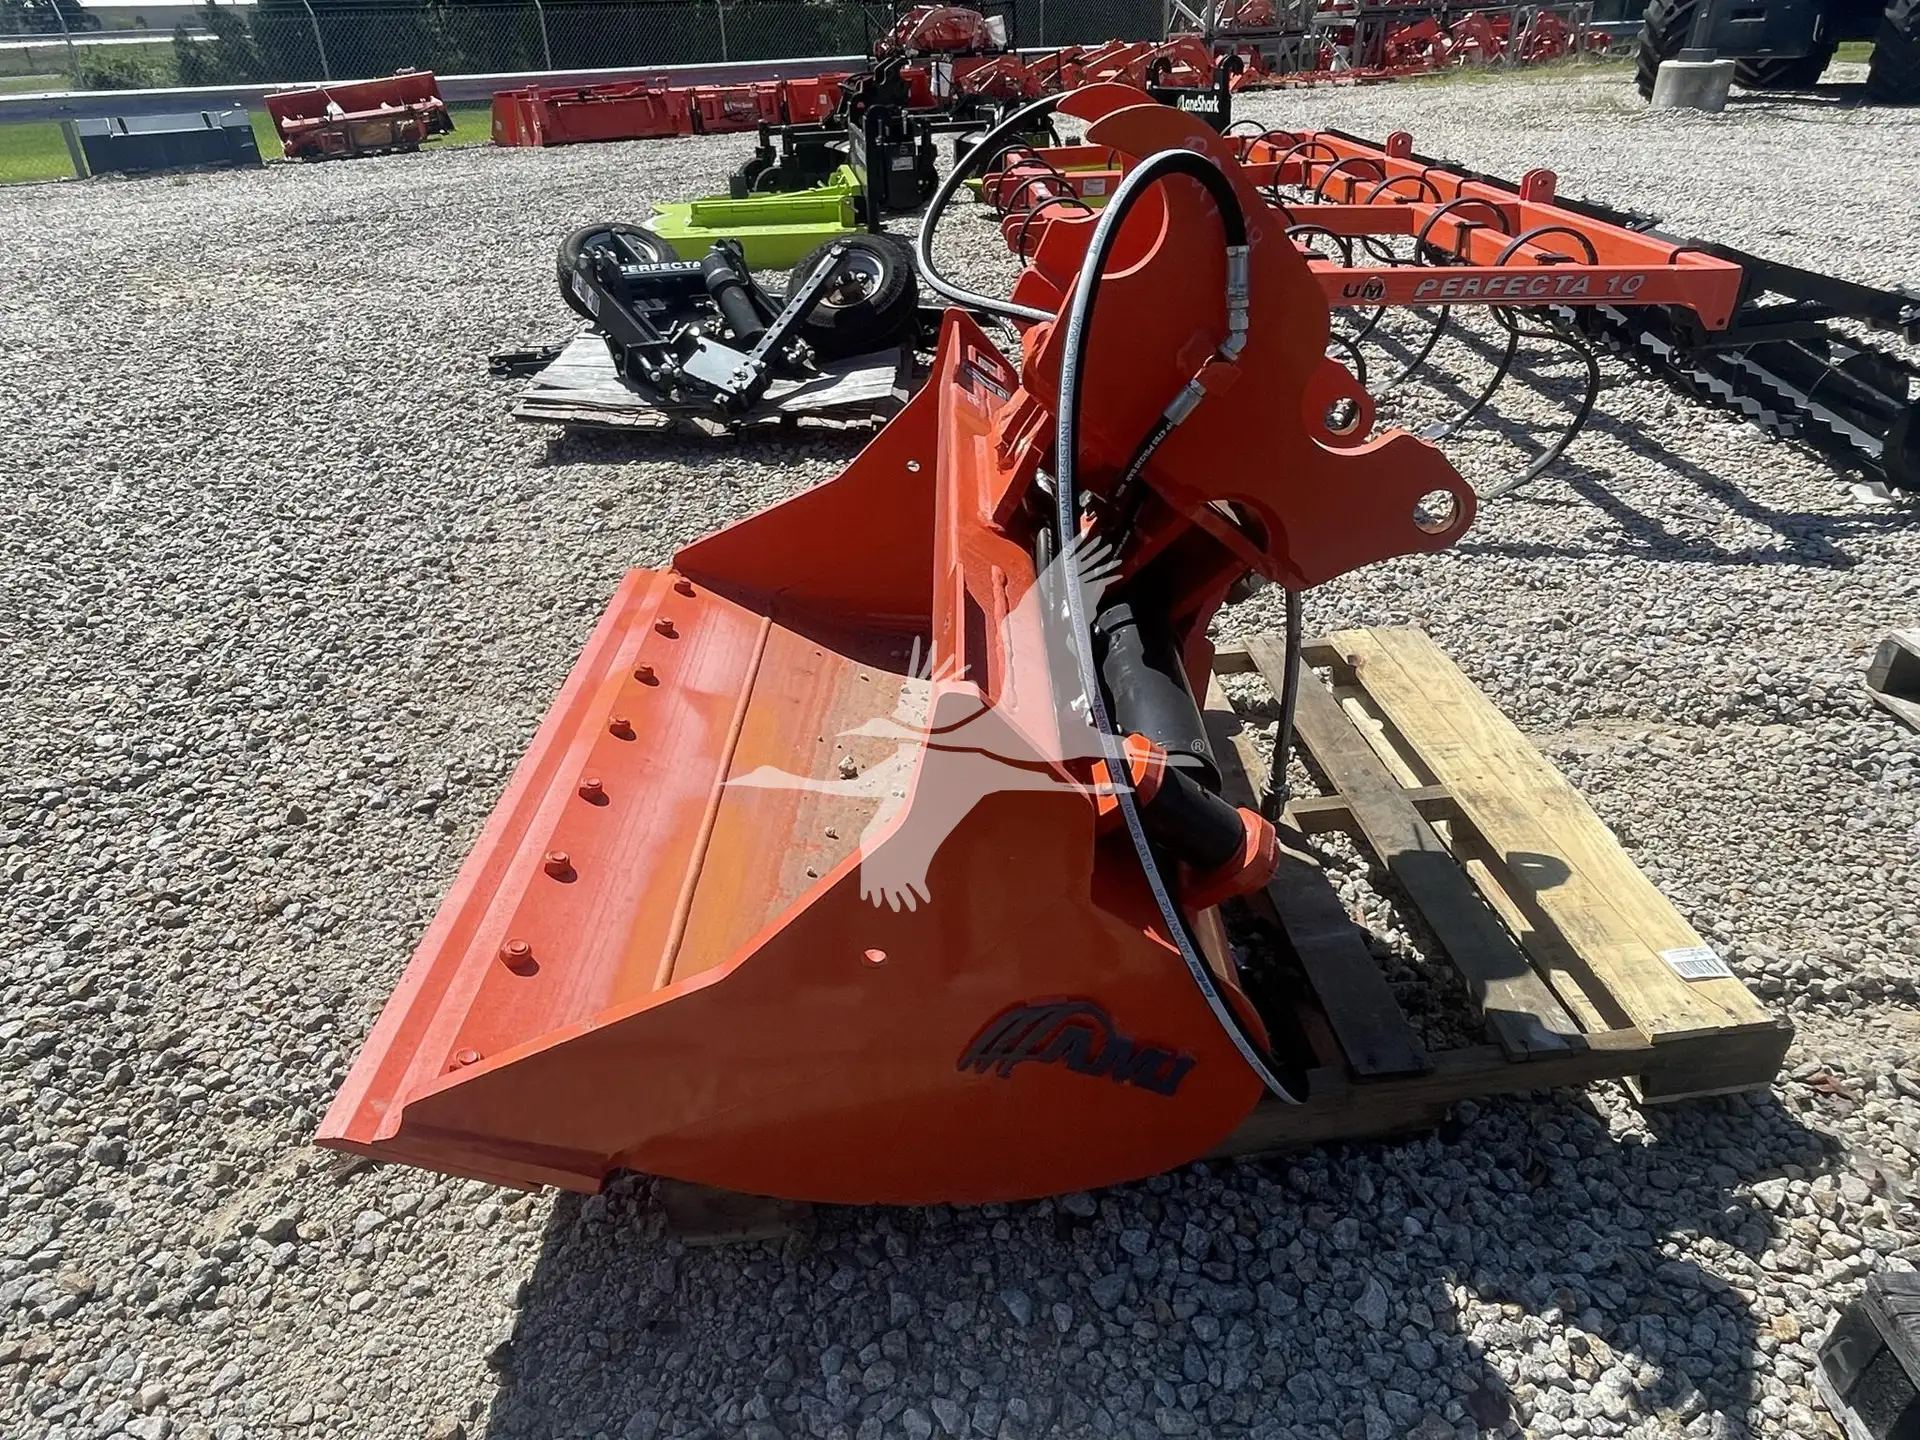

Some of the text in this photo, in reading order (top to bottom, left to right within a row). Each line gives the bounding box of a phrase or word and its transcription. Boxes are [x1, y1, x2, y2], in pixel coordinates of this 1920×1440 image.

[1180, 94, 1219, 113] LaneShark
[619, 261, 701, 273] PERFECTA
[1414, 275, 1588, 297] PERFECTA
[1607, 274, 1646, 294] 10
[1062, 362, 1074, 396] MSHA
[1060, 419, 1070, 483] RESISTANT
[1060, 486, 1071, 526] FLAME
